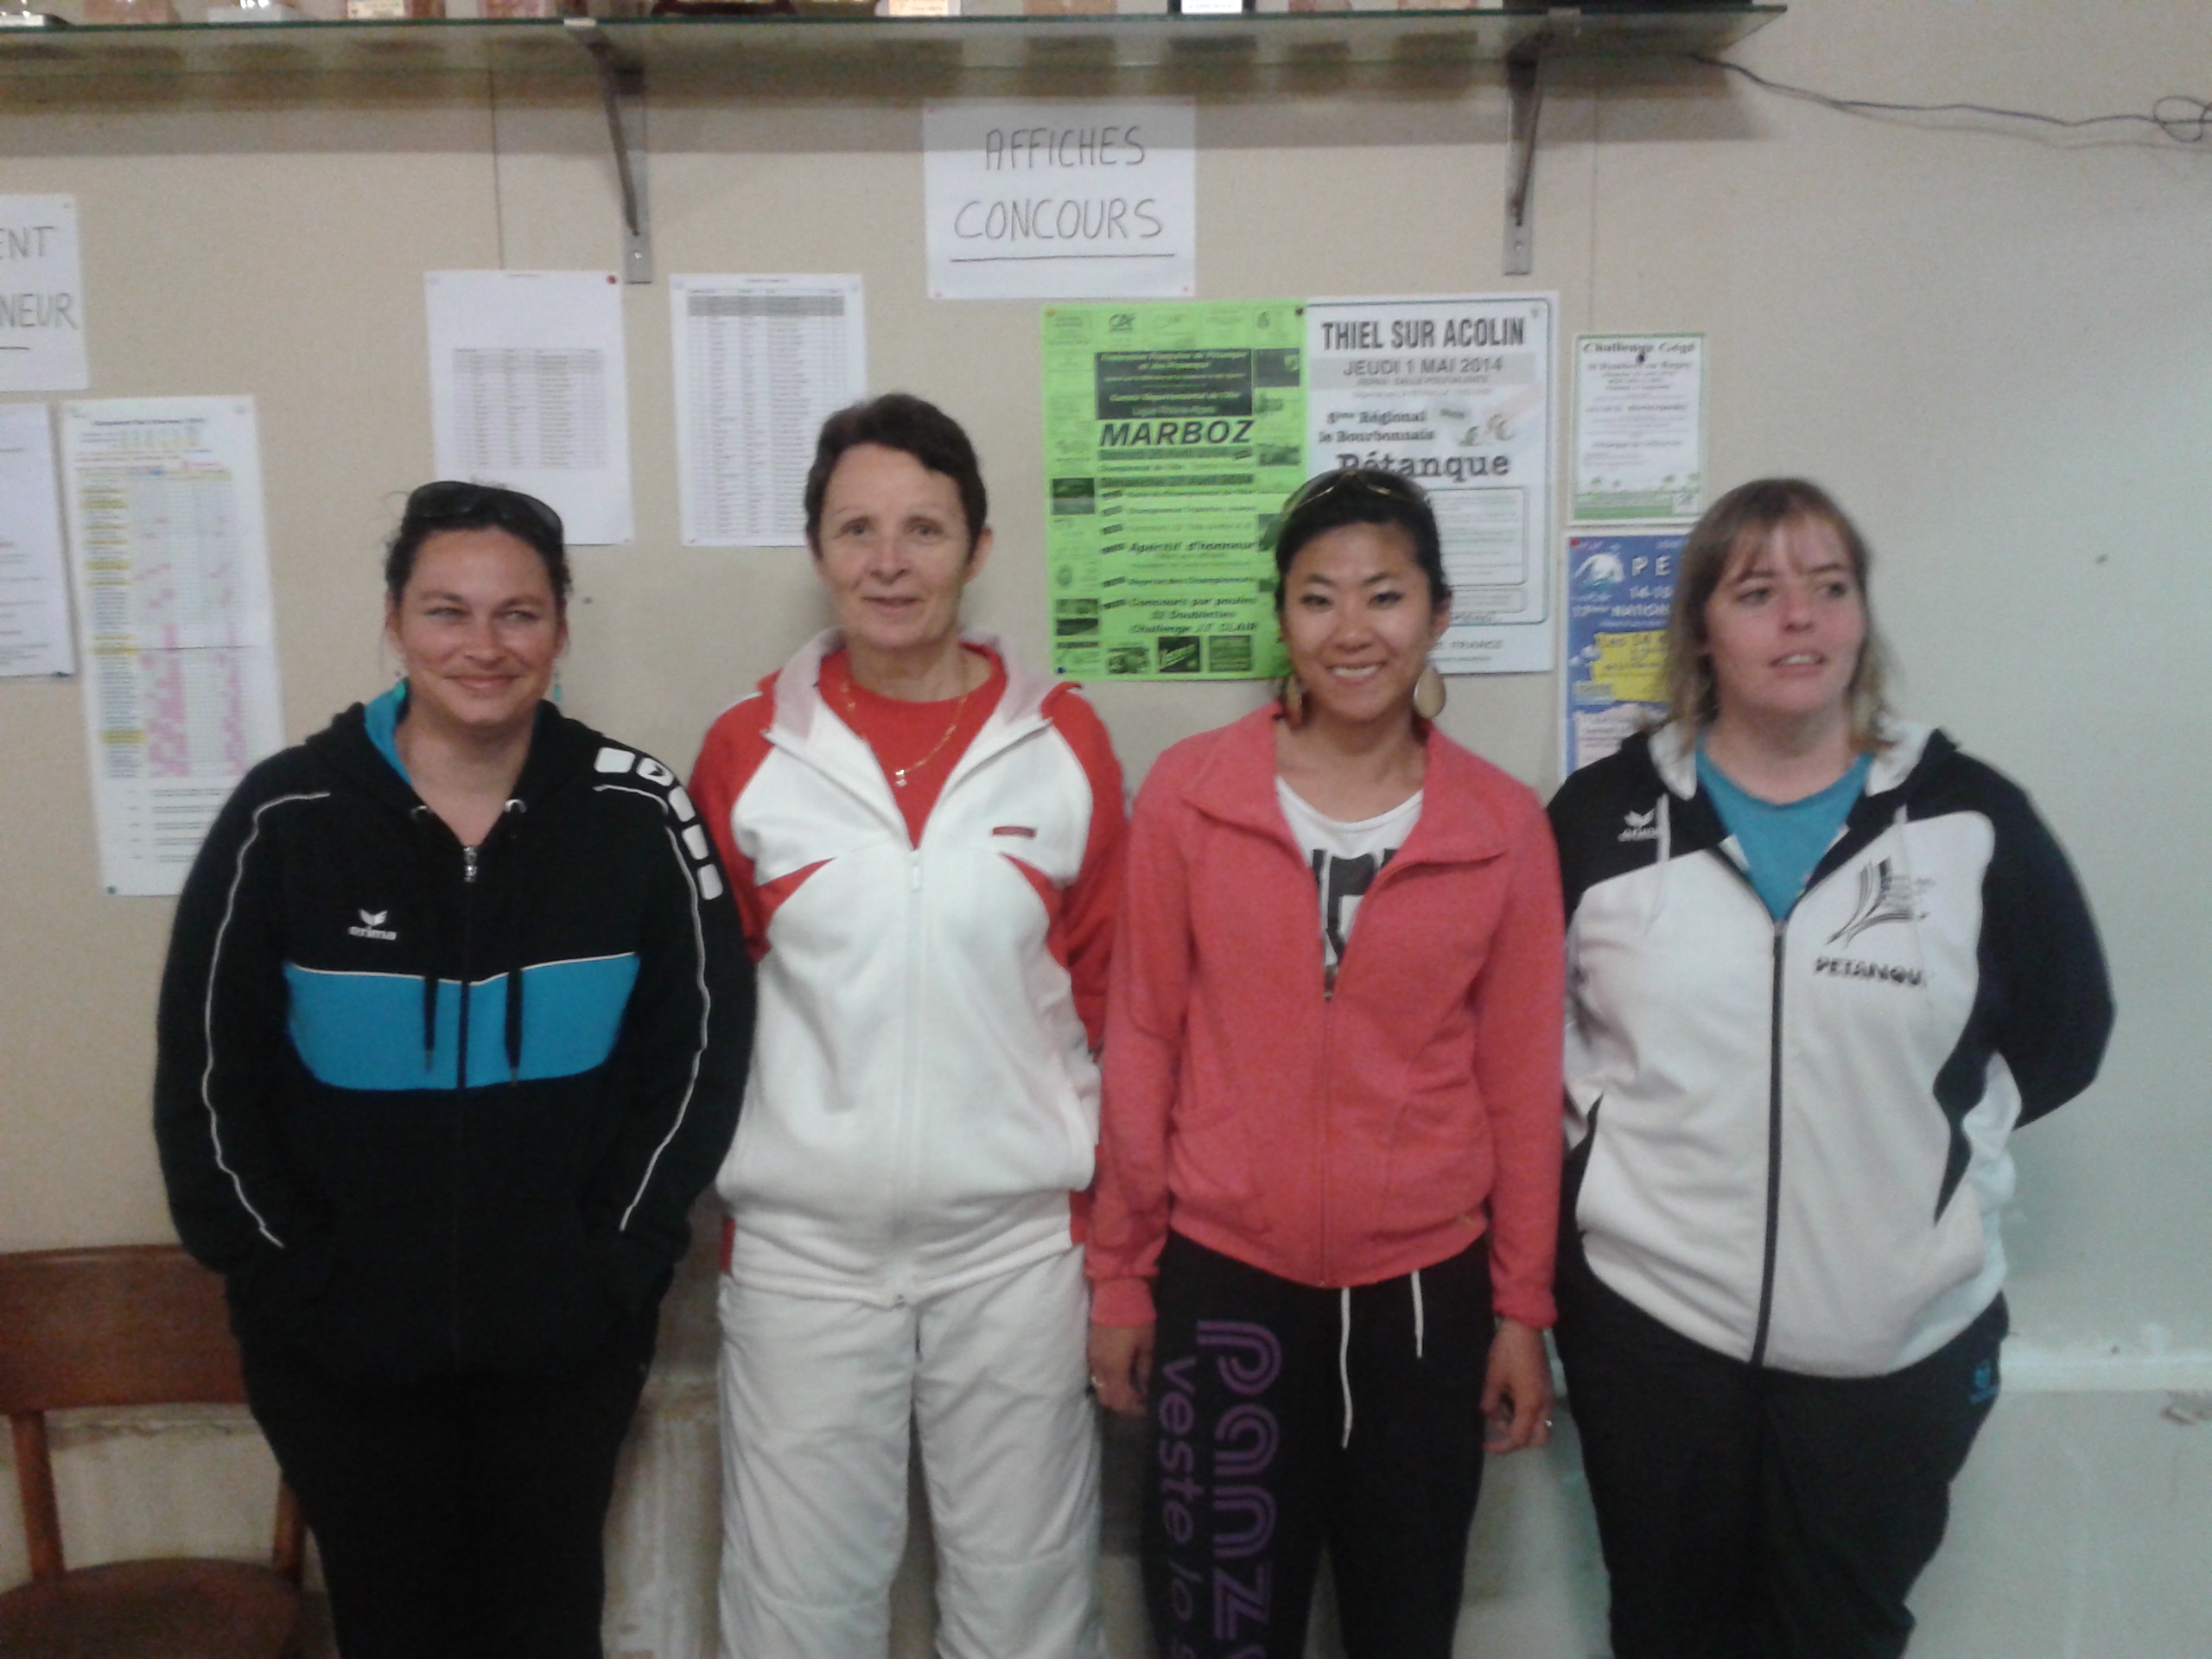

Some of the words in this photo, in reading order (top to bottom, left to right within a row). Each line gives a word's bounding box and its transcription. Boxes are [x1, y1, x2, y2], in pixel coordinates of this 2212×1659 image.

[986, 125, 1145, 170] AFFICHES
[954, 198, 1163, 241] CONCOURS
[0, 226, 59, 257] NT
[1320, 321, 1383, 351] THIEL
[1390, 319, 1436, 349] SUR
[1442, 316, 1526, 347] ACOLIN
[1343, 359, 1401, 376] JEUDI
[1406, 359, 1415, 374] 1
[1421, 357, 1457, 374] MAI
[1460, 355, 1504, 372] 2014
[1100, 419, 1255, 447] MARBOZ
[1815, 956, 1927, 988] PETANQU
[1159, 1355, 1204, 1545] veste
